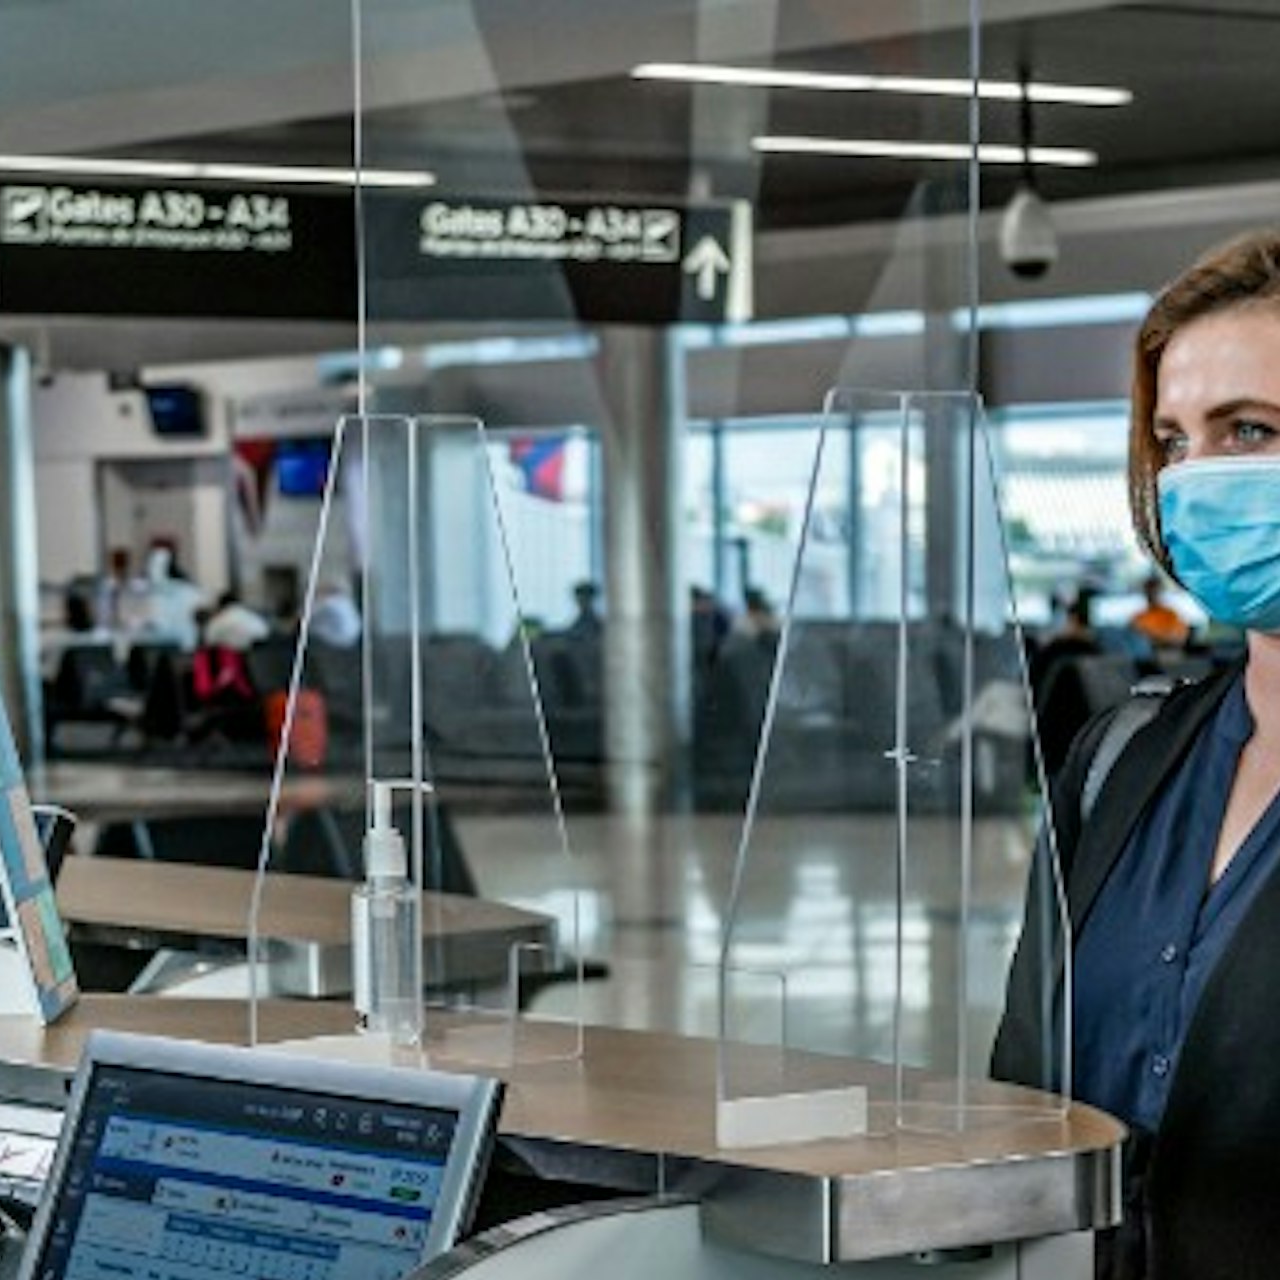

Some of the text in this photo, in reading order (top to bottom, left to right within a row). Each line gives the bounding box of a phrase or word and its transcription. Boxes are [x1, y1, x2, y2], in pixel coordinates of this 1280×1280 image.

[50, 187, 135, 226] Gates
[138, 190, 205, 228] A30
[420, 202, 504, 237] Gates
